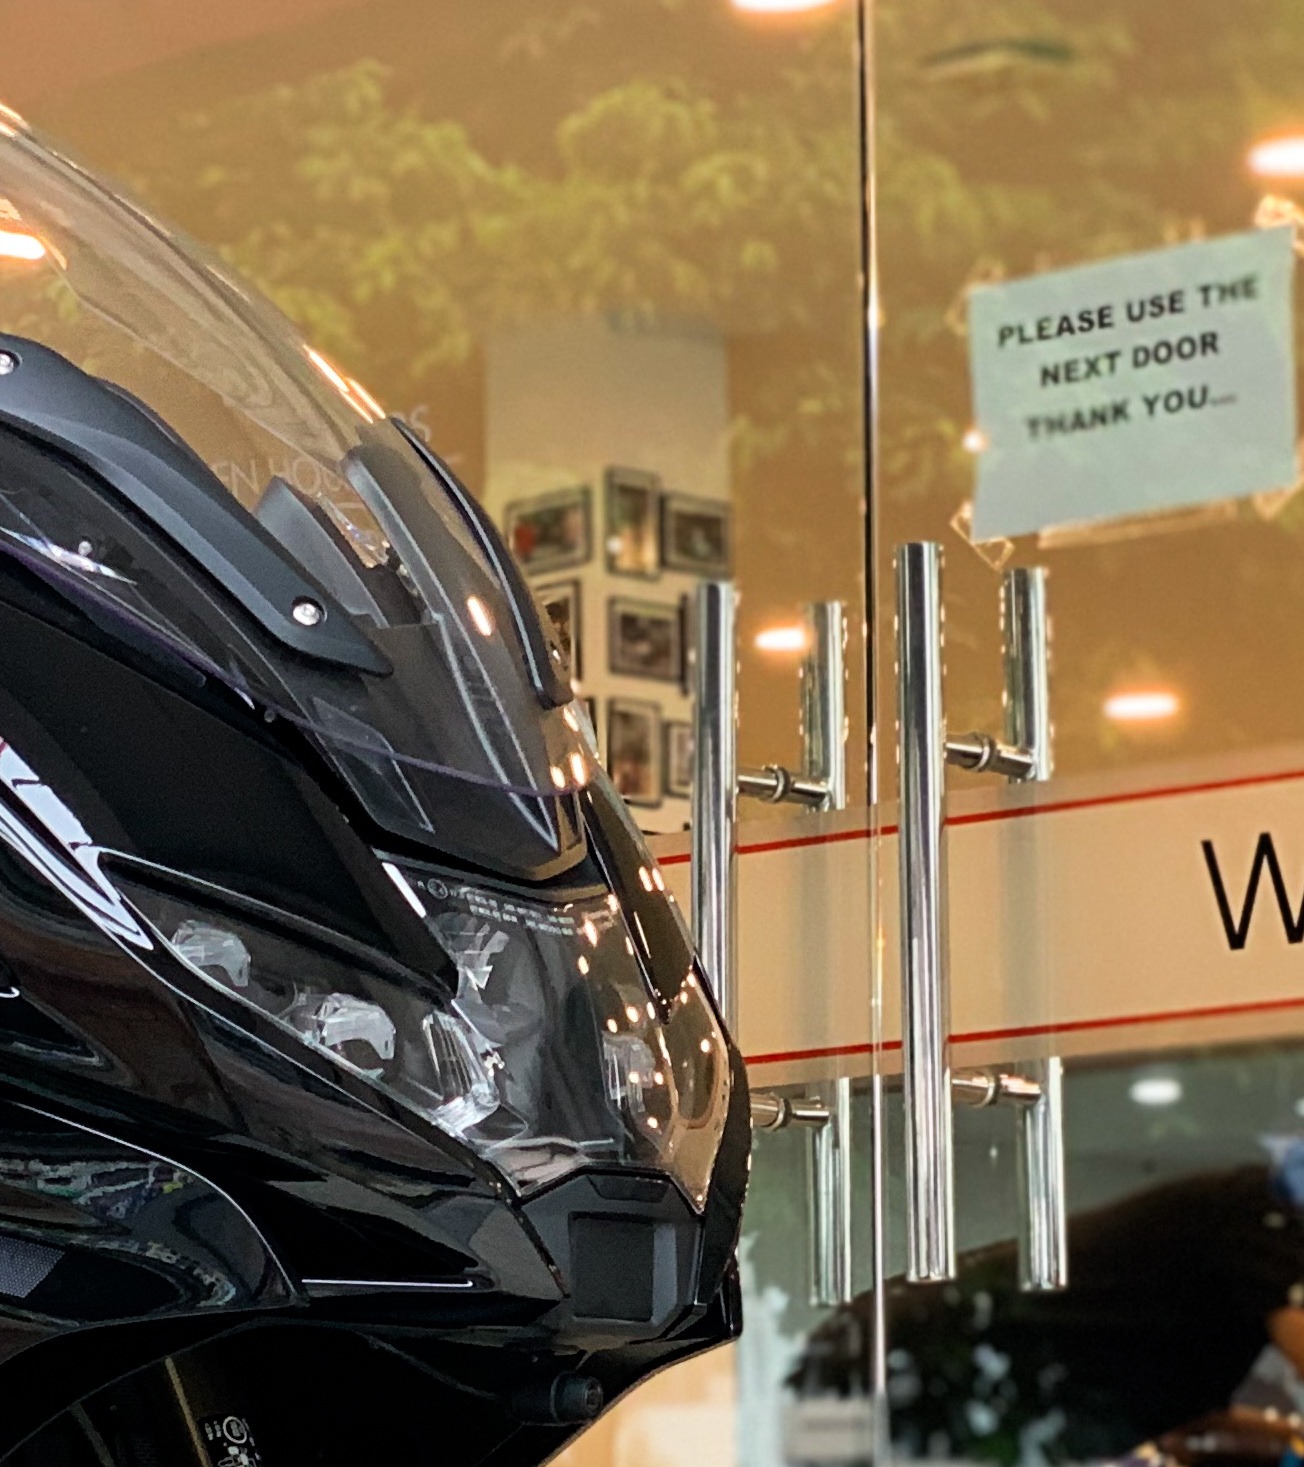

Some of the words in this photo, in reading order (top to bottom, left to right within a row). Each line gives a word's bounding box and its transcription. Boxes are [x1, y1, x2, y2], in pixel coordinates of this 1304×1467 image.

[998, 306, 1114, 347] PLEASE
[1127, 290, 1185, 322] USE
[1199, 275, 1259, 307] THE
[1040, 351, 1121, 387] NEXT
[1132, 332, 1220, 368] DOOR
[1026, 399, 1130, 439] THANK
